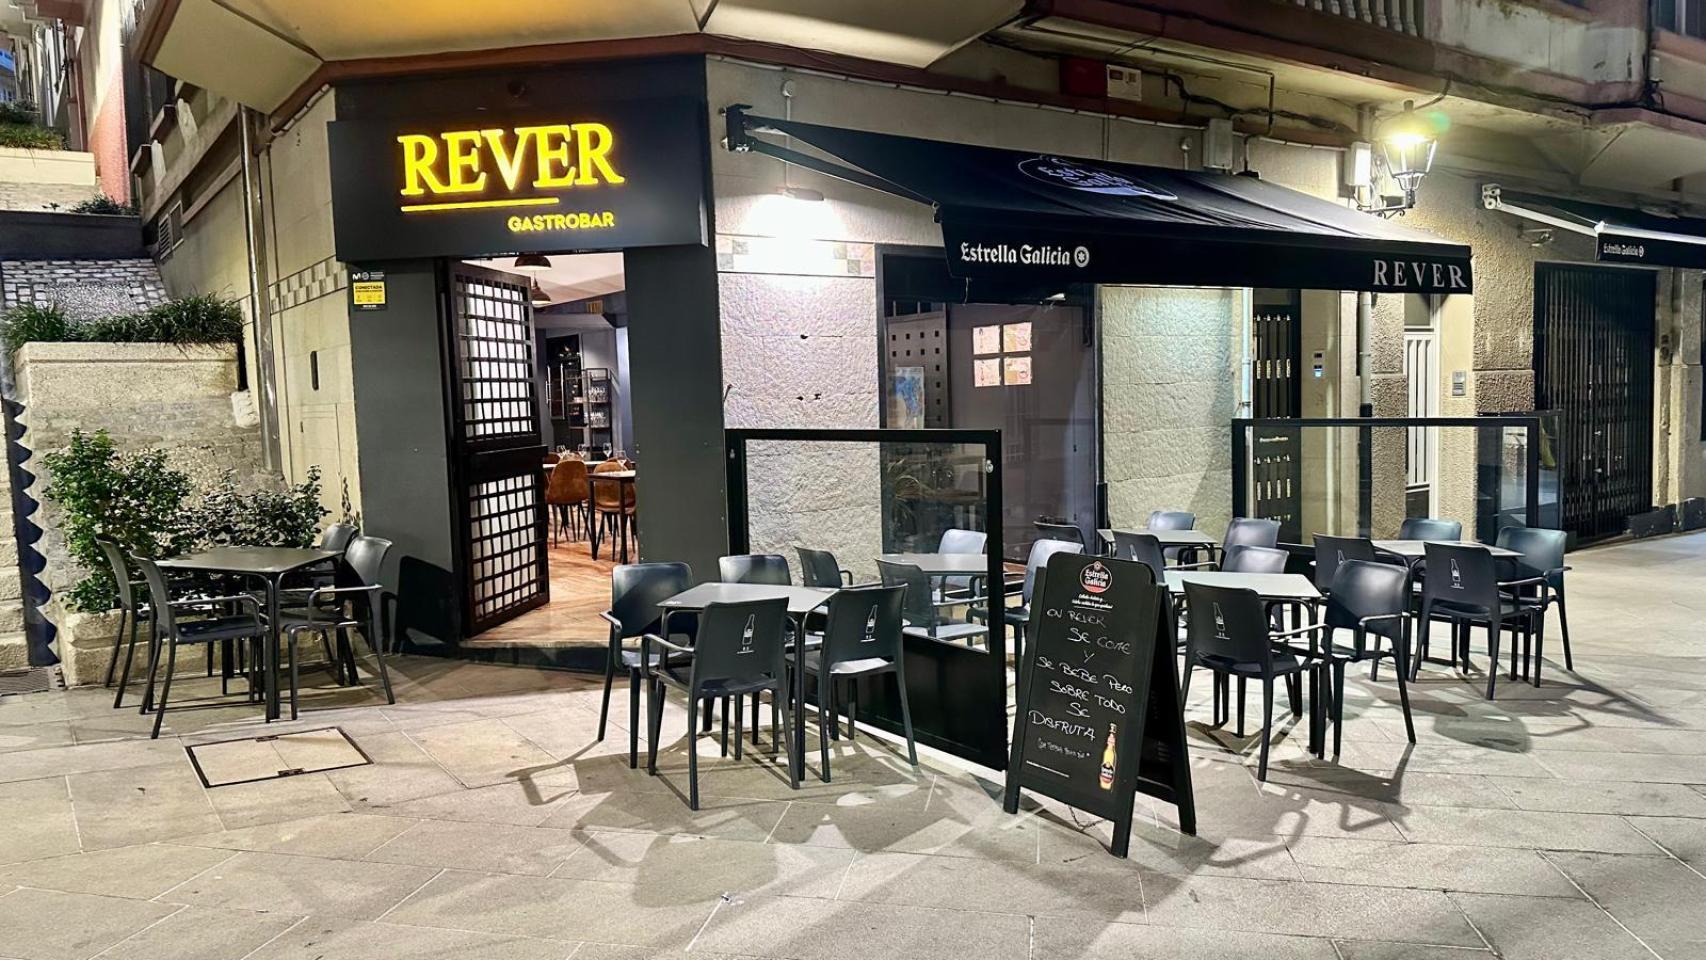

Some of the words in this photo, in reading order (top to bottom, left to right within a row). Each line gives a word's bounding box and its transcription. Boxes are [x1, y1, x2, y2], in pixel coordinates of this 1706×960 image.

[397, 122, 625, 196] REVER
[507, 211, 615, 233] GASTROBAR
[960, 241, 1017, 263] Estrella
[1020, 244, 1070, 265] Galicia
[1372, 259, 1468, 288] REVER
